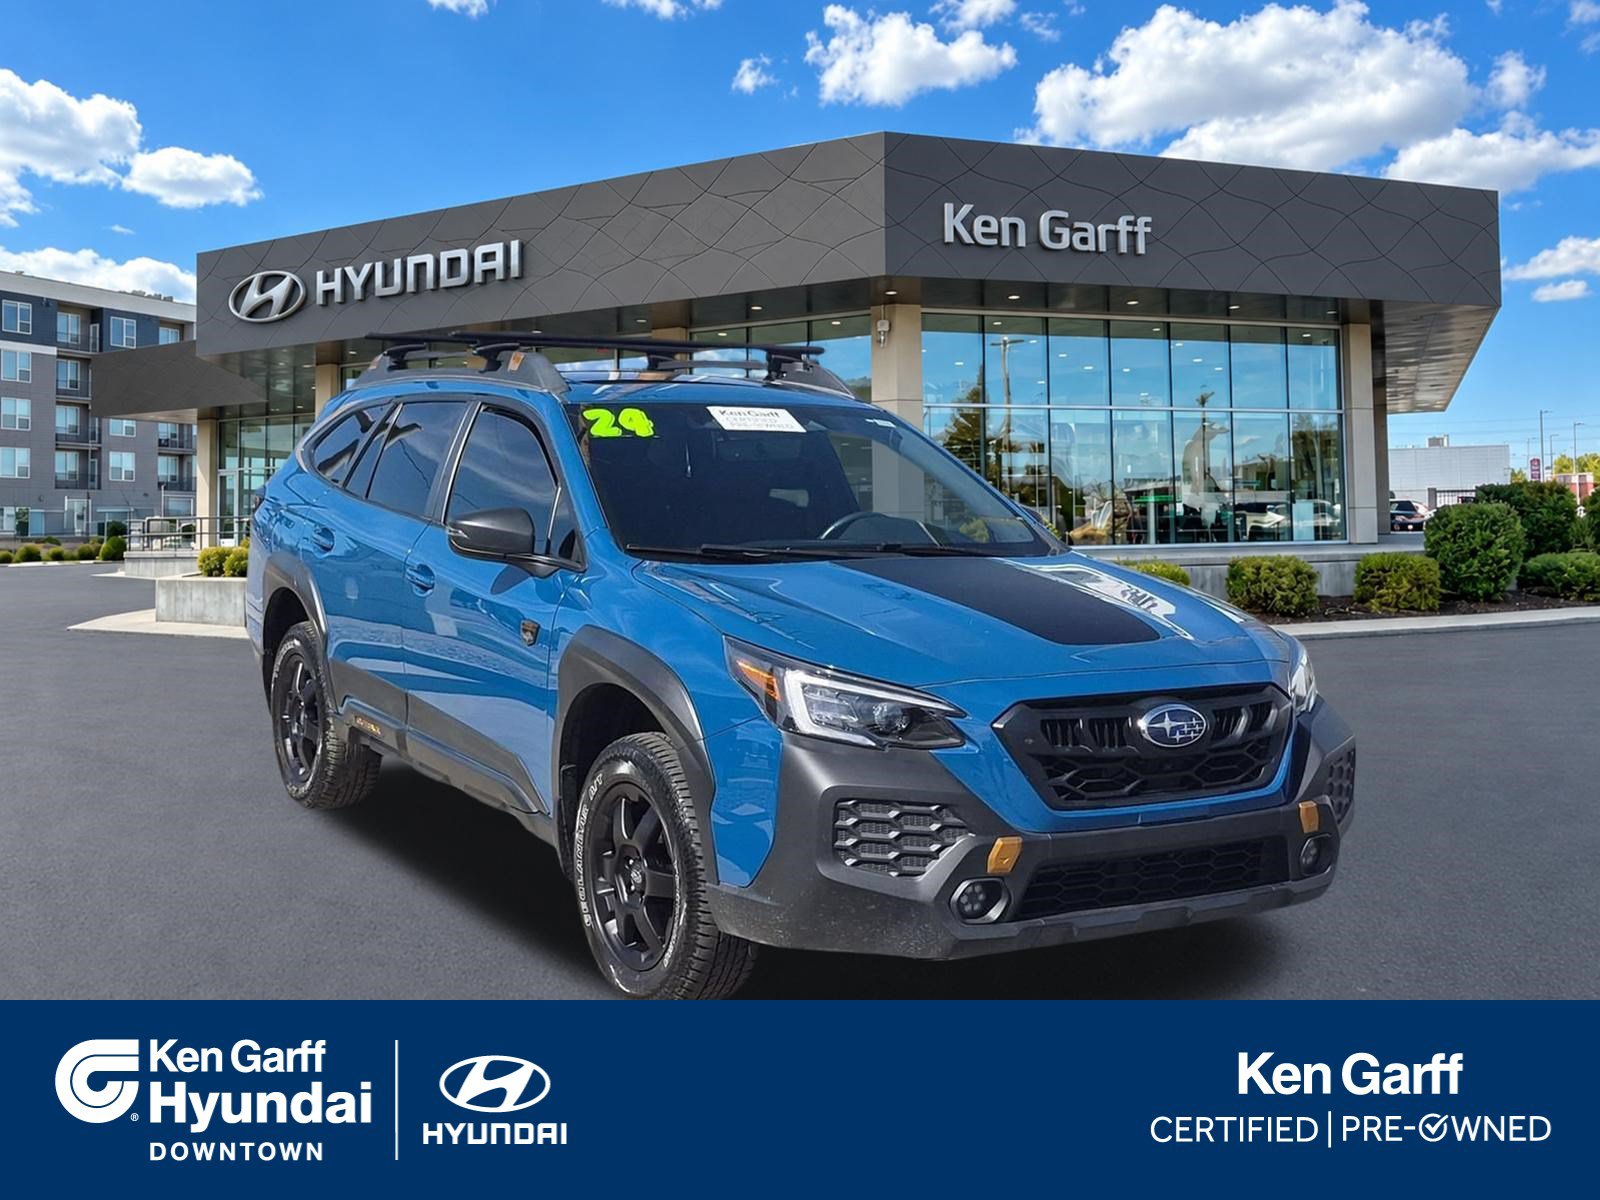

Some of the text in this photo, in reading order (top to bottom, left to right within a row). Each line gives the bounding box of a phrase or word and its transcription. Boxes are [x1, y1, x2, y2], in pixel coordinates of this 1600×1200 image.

[943, 202, 1153, 255] Ken Garff
[315, 239, 523, 306] HYUNDAI
[583, 407, 654, 438] 24
